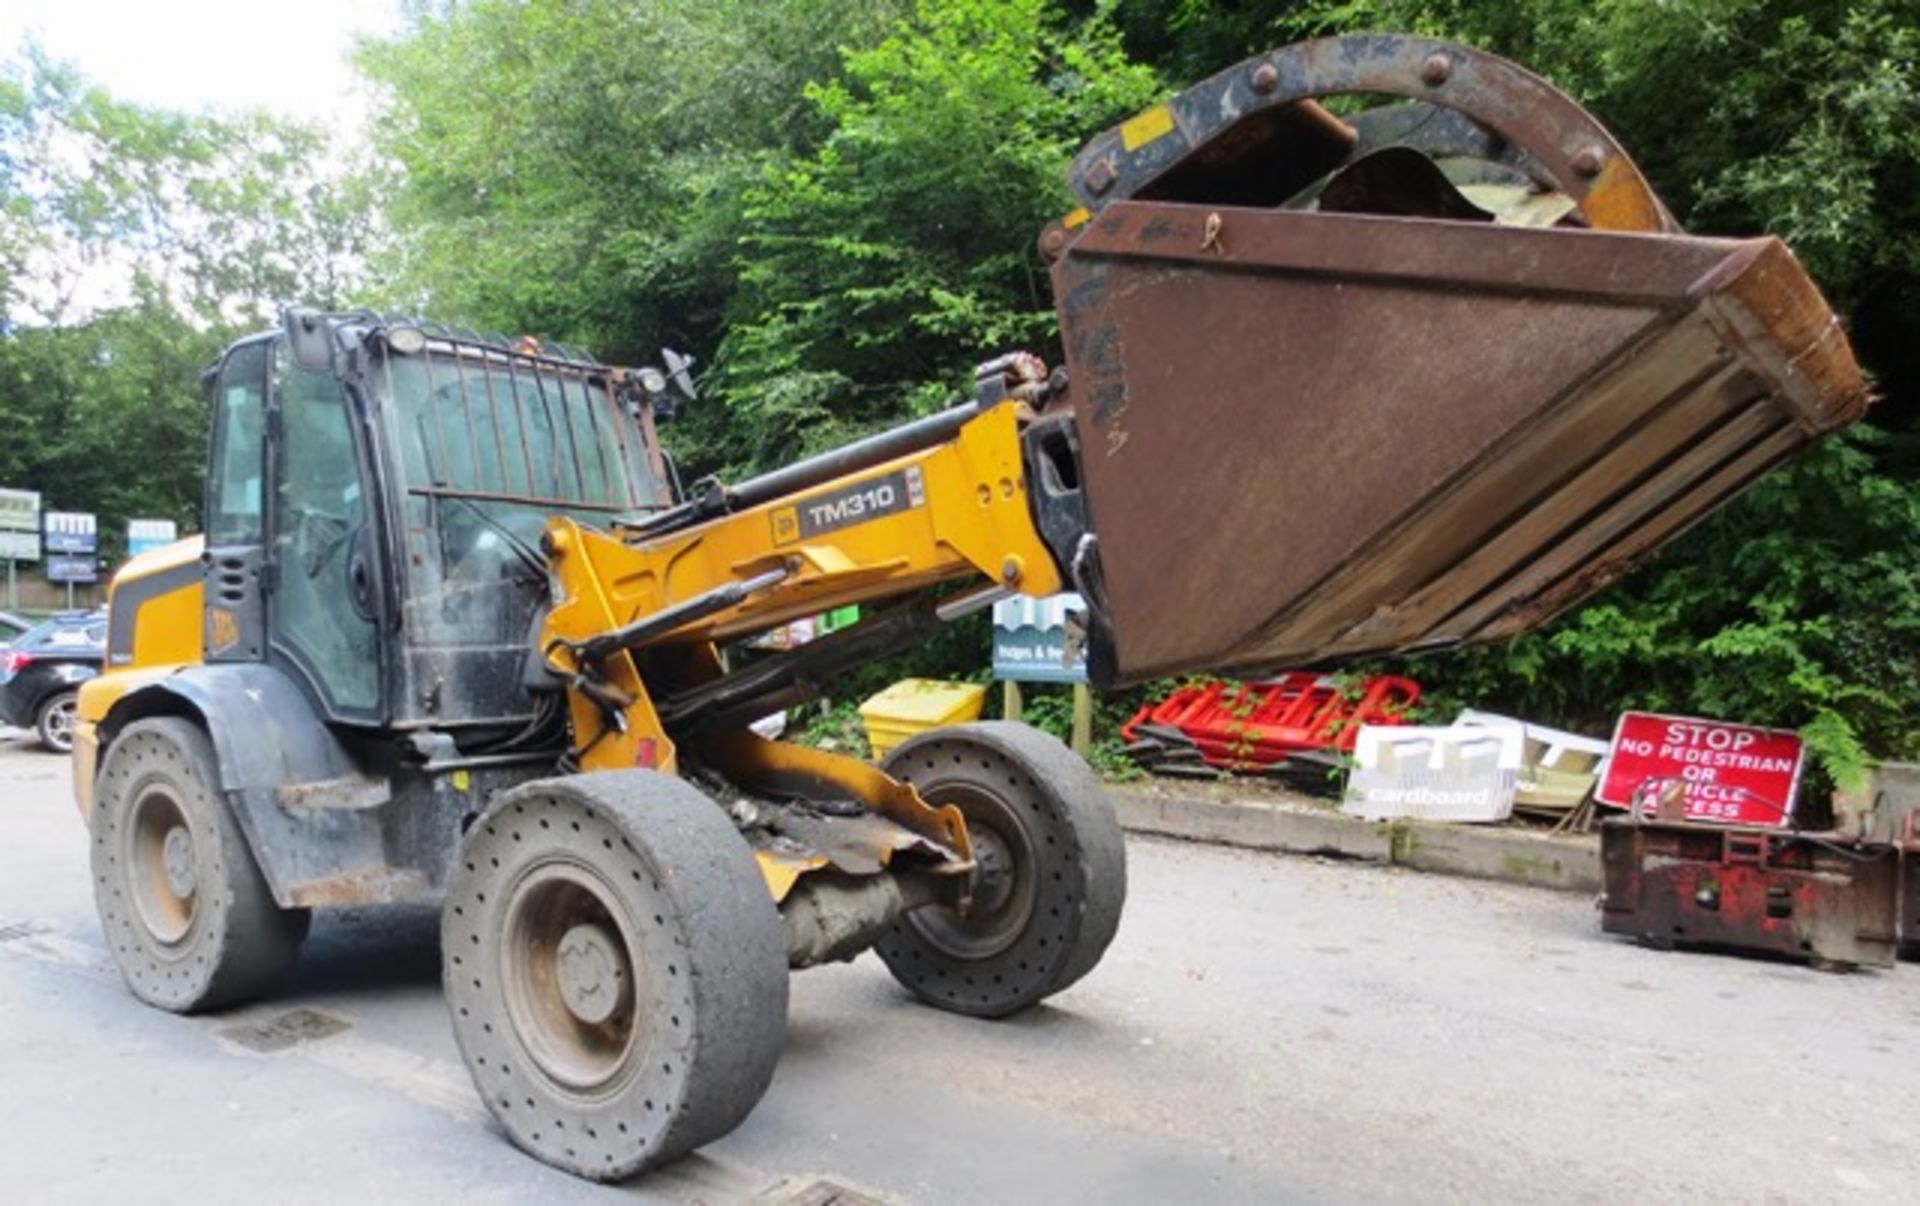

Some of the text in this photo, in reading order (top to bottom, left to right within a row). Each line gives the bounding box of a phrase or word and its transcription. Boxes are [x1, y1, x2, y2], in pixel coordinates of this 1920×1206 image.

[809, 484, 895, 527] TM310
[1664, 722, 1755, 751] STOP
[1619, 738, 1792, 773] NO PEDESTRIAN
[1682, 765, 1717, 782] OR
[1643, 794, 1740, 817] AESS
